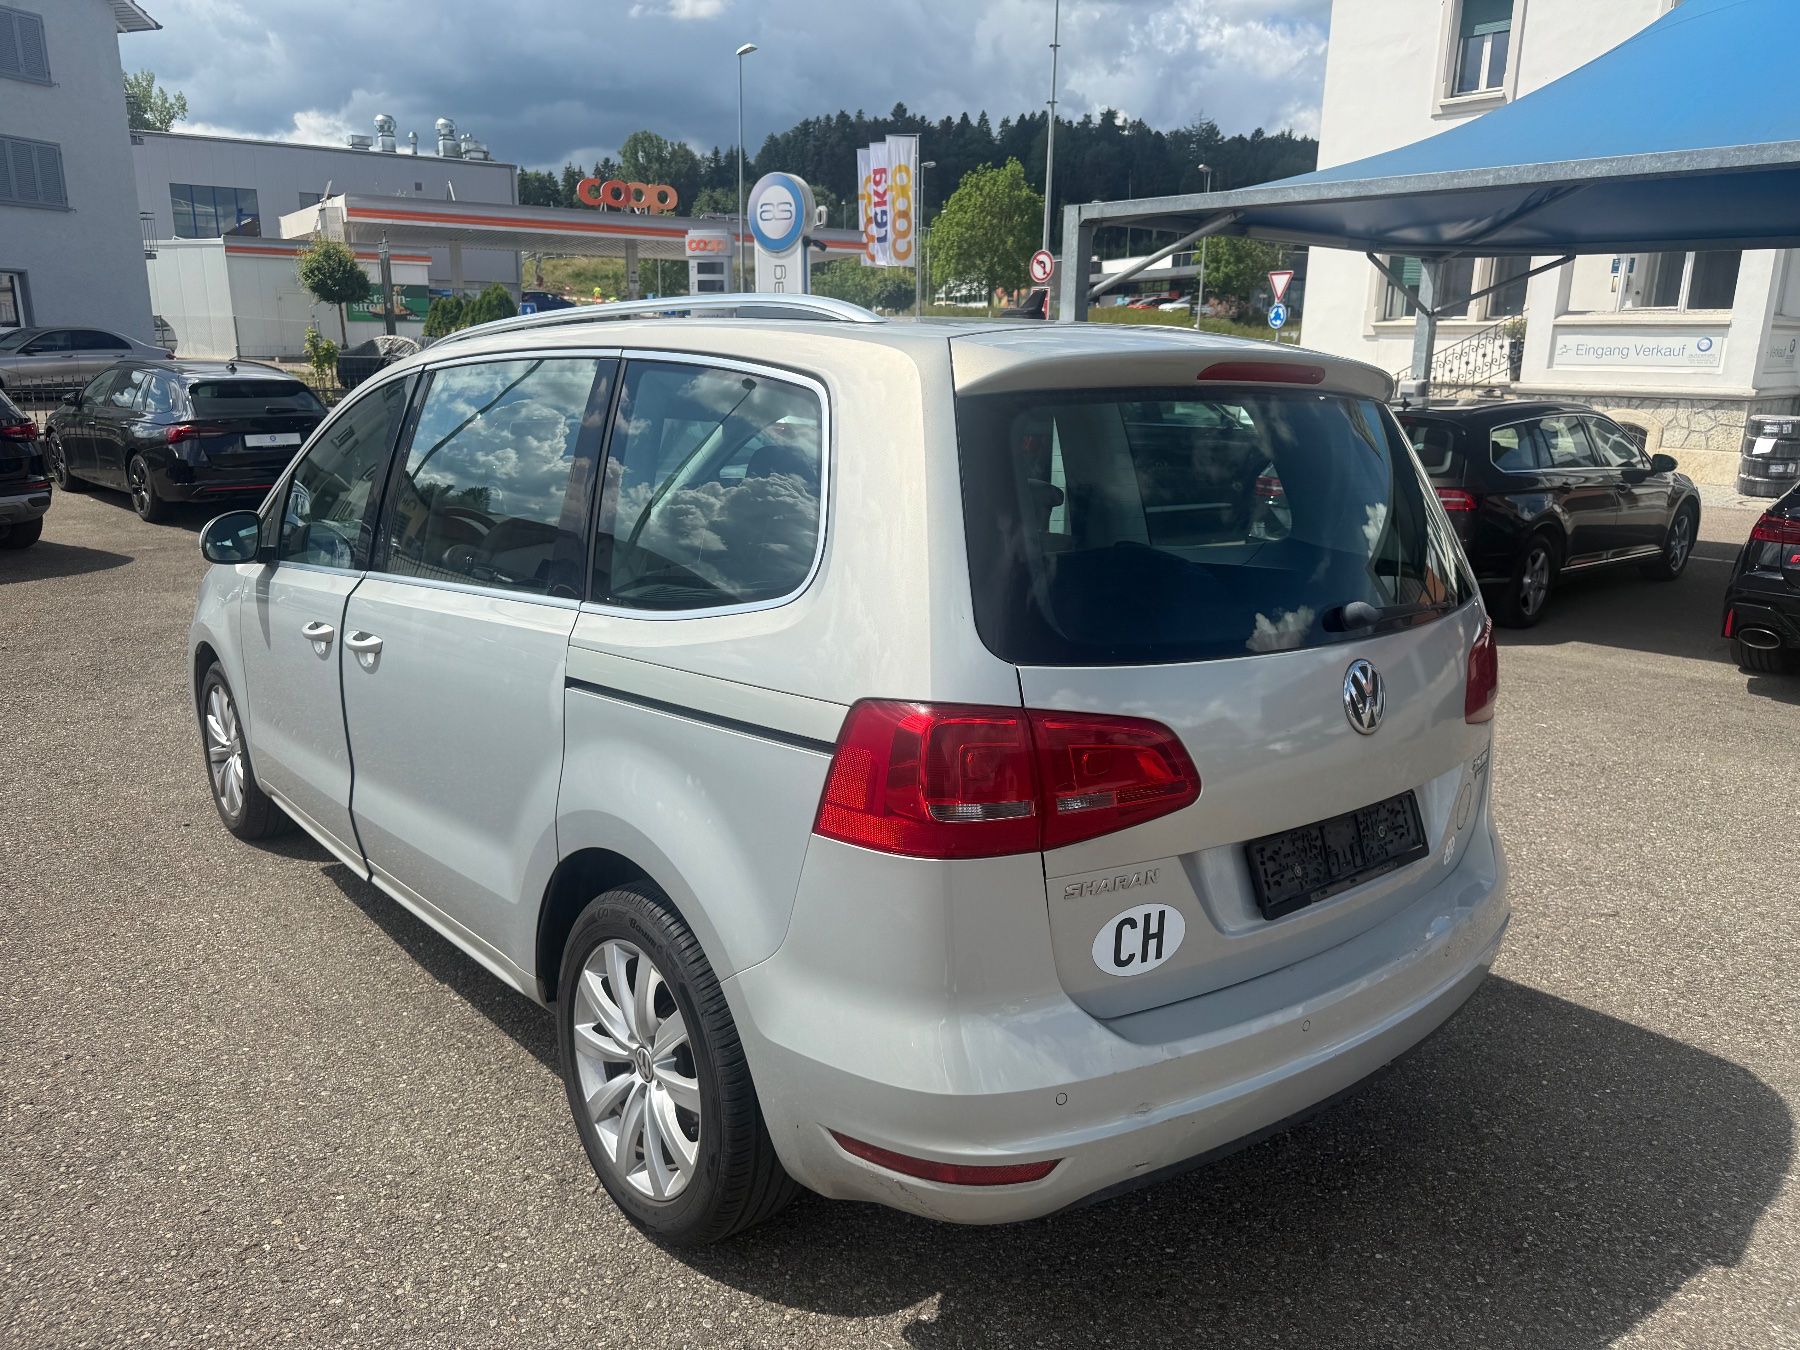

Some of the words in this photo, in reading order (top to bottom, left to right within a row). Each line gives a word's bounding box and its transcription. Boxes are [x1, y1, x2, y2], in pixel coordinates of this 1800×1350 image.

[576, 177, 678, 216] coop
[1576, 344, 1629, 359] Eingang
[1634, 344, 1687, 357] Verkauf
[1343, 659, 1386, 735] VW
[1063, 868, 1161, 900] SHARAN
[1113, 909, 1166, 967] CH
